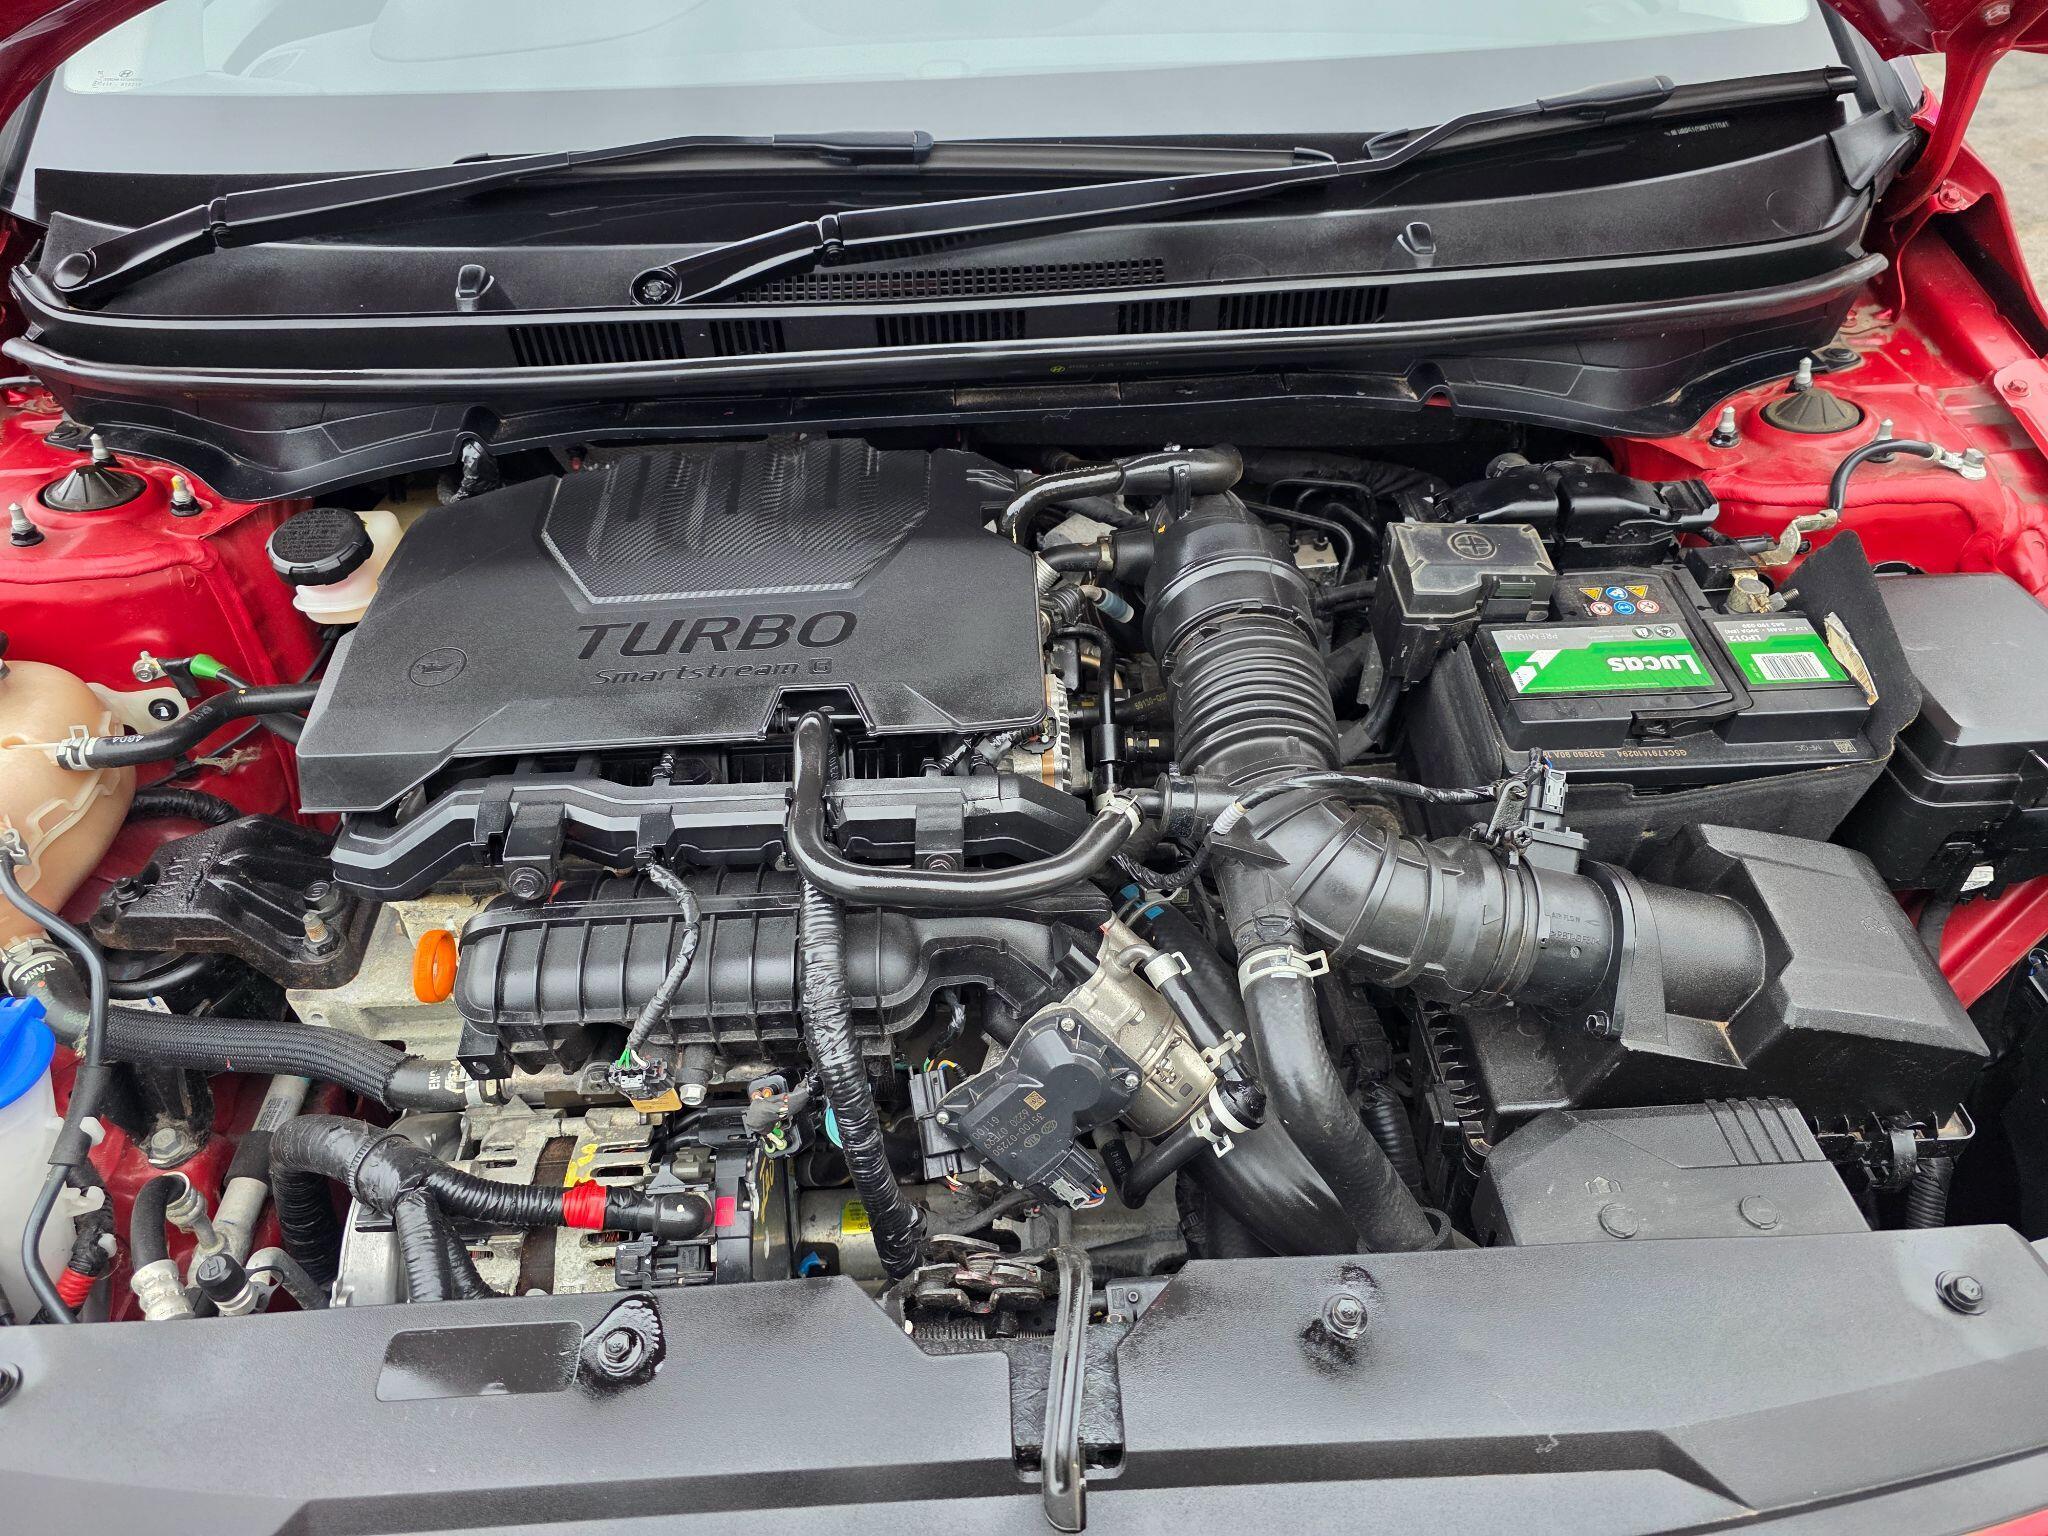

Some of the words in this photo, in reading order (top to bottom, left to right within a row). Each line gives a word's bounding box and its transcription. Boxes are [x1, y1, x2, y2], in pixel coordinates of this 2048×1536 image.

[577, 610, 858, 660] TURBO
[1506, 632, 1559, 641] PREMIUM
[593, 661, 799, 684] Smartstream
[1606, 654, 1702, 675] Lucas
[21, 963, 56, 985] TANK
